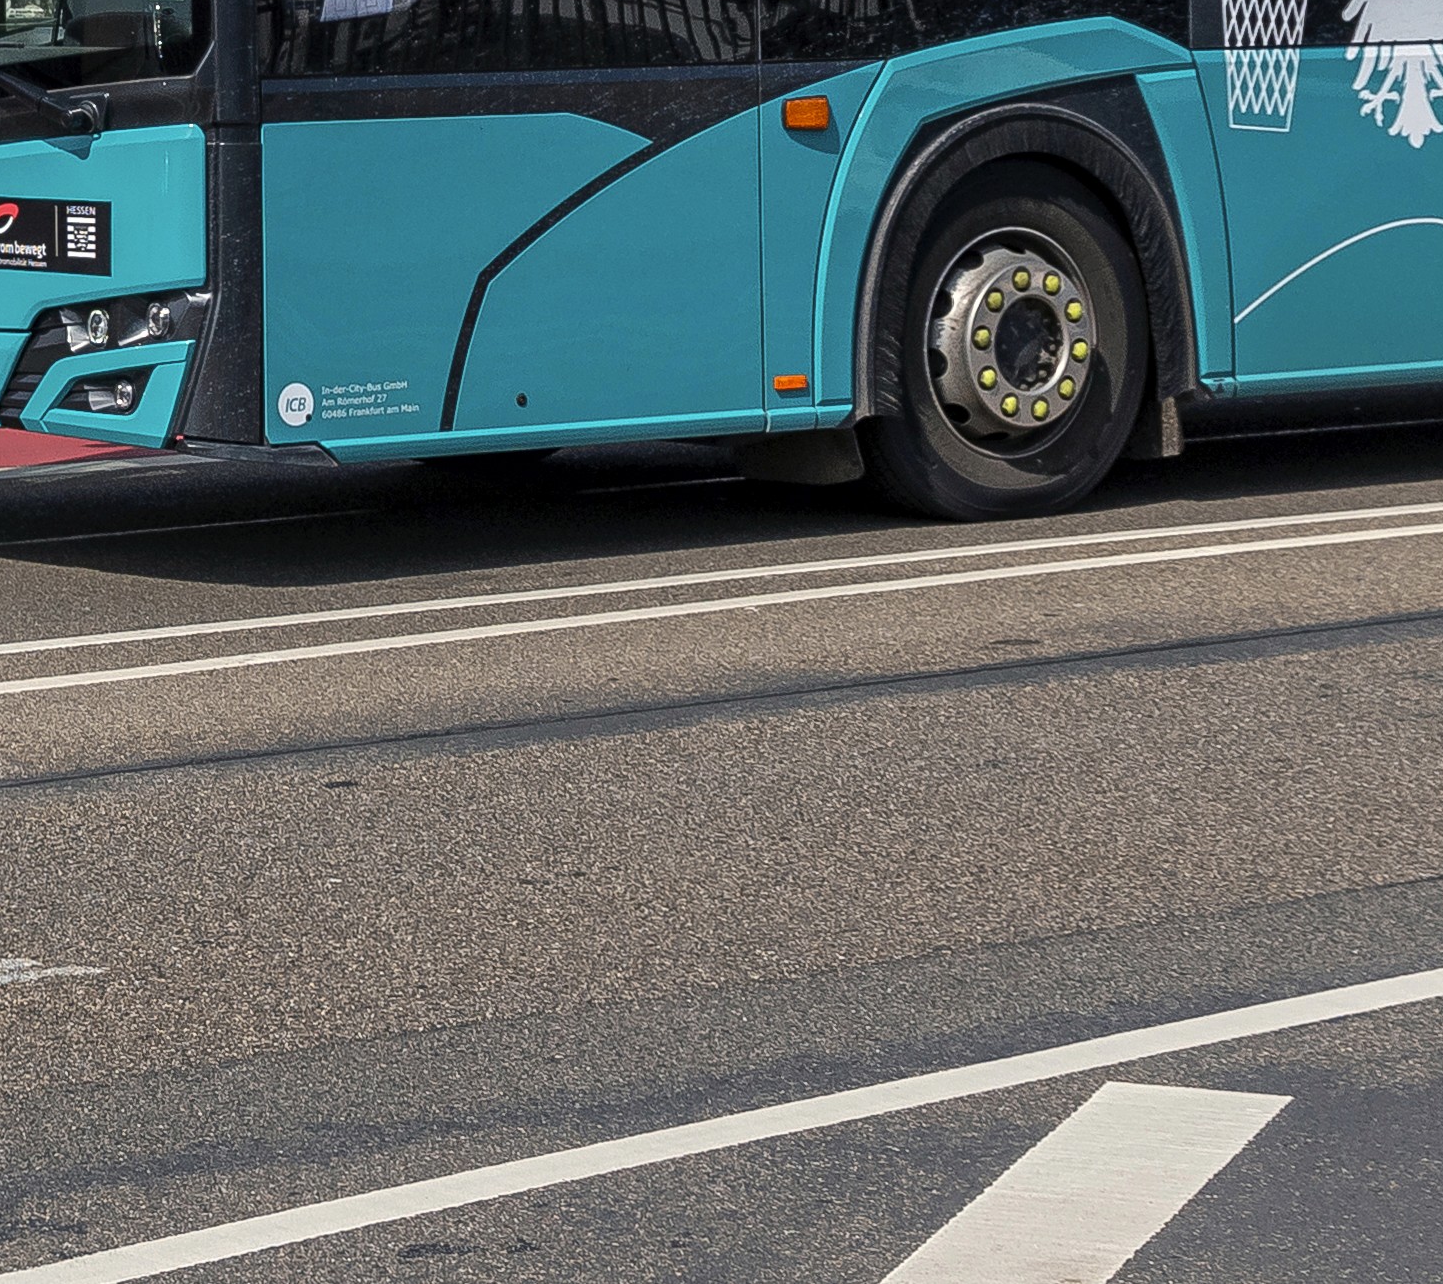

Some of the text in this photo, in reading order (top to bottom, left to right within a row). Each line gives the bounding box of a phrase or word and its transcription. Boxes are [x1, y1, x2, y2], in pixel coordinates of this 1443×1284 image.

[66, 205, 96, 216] HESSEN
[14, 240, 47, 259] bewegt
[321, 380, 408, 395] In-der-City-Bus GmbH
[285, 397, 307, 413] ICB
[322, 394, 388, 407] Am Römerhof 27
[321, 403, 420, 420] 60486 Frankfurt am Main
